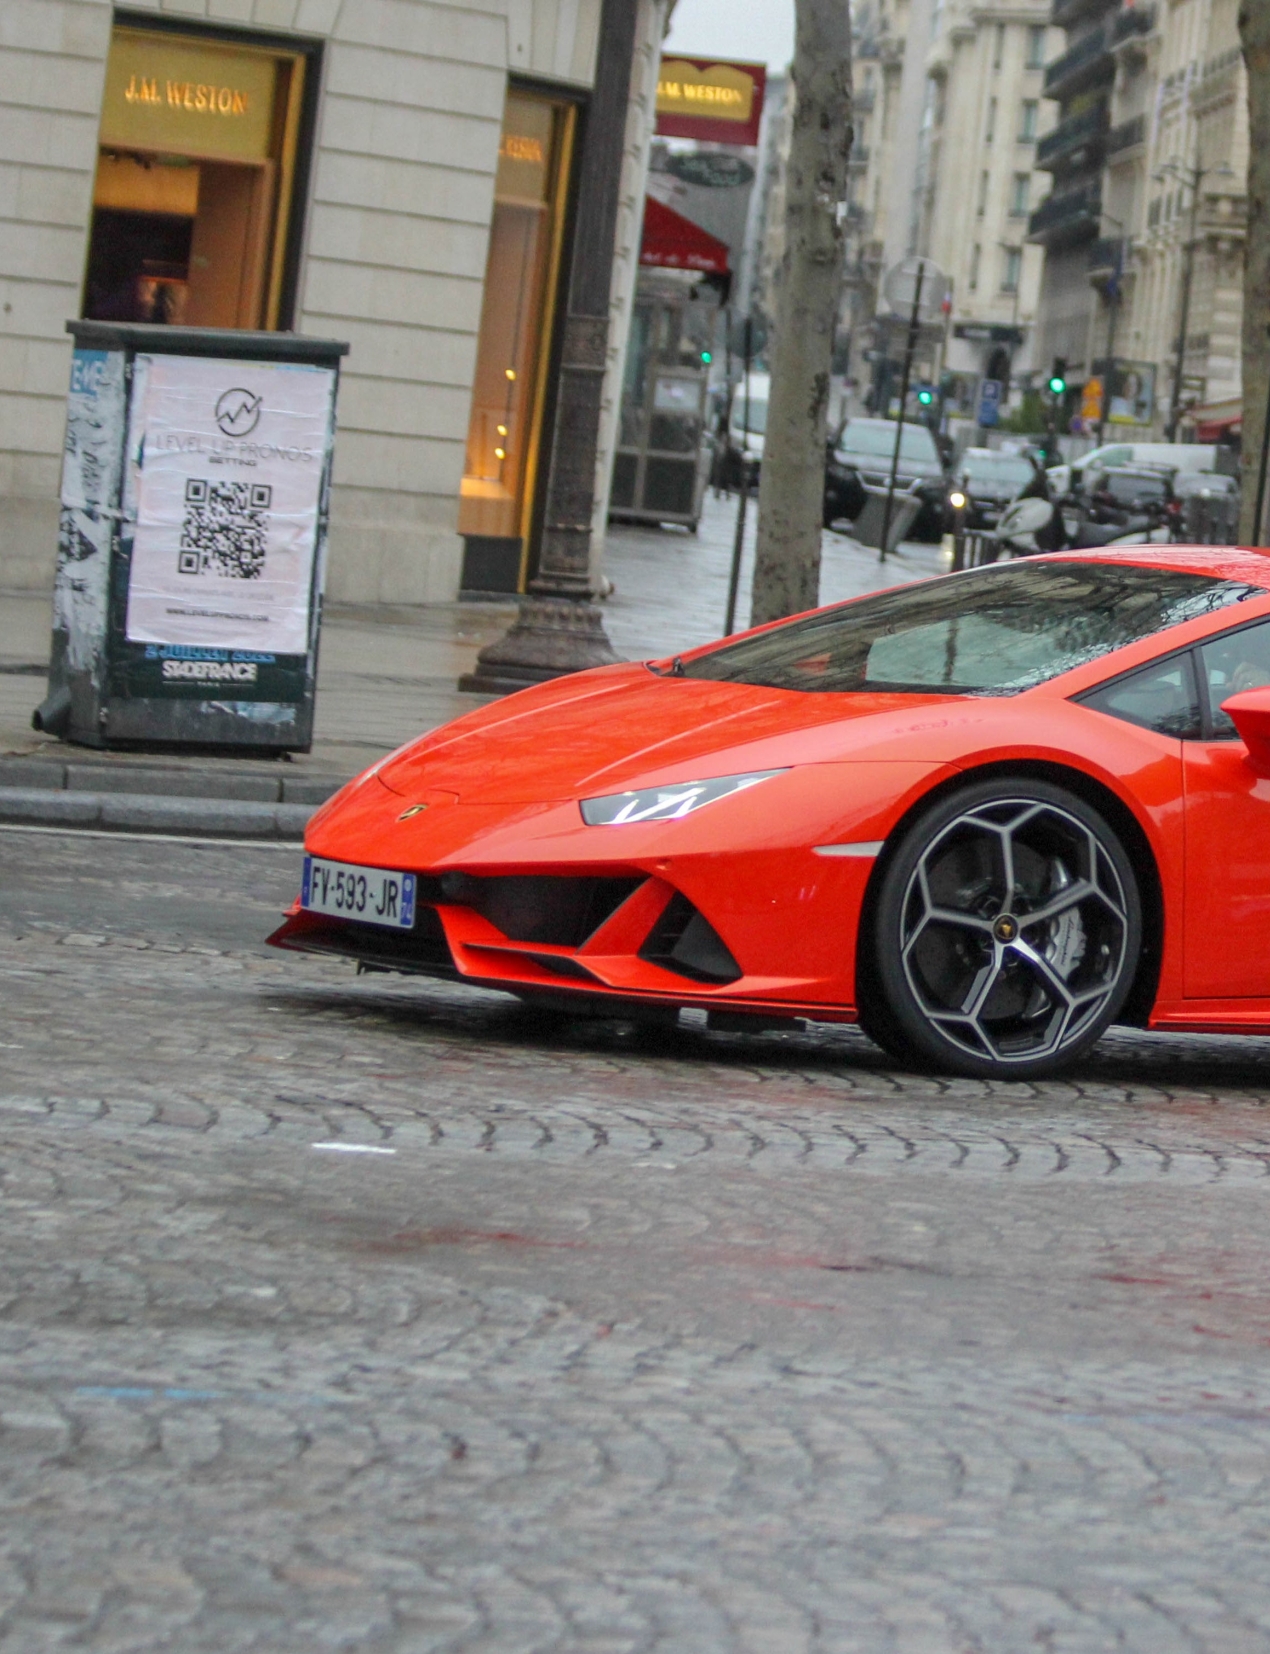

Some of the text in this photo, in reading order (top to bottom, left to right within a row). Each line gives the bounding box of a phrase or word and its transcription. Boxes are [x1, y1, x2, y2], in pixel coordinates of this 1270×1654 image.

[166, 80, 249, 116] WESTON
[682, 83, 744, 106] WESTON
[155, 435, 205, 453] LEVEL
[239, 442, 313, 463] PRONOS
[208, 456, 258, 467] BETTING
